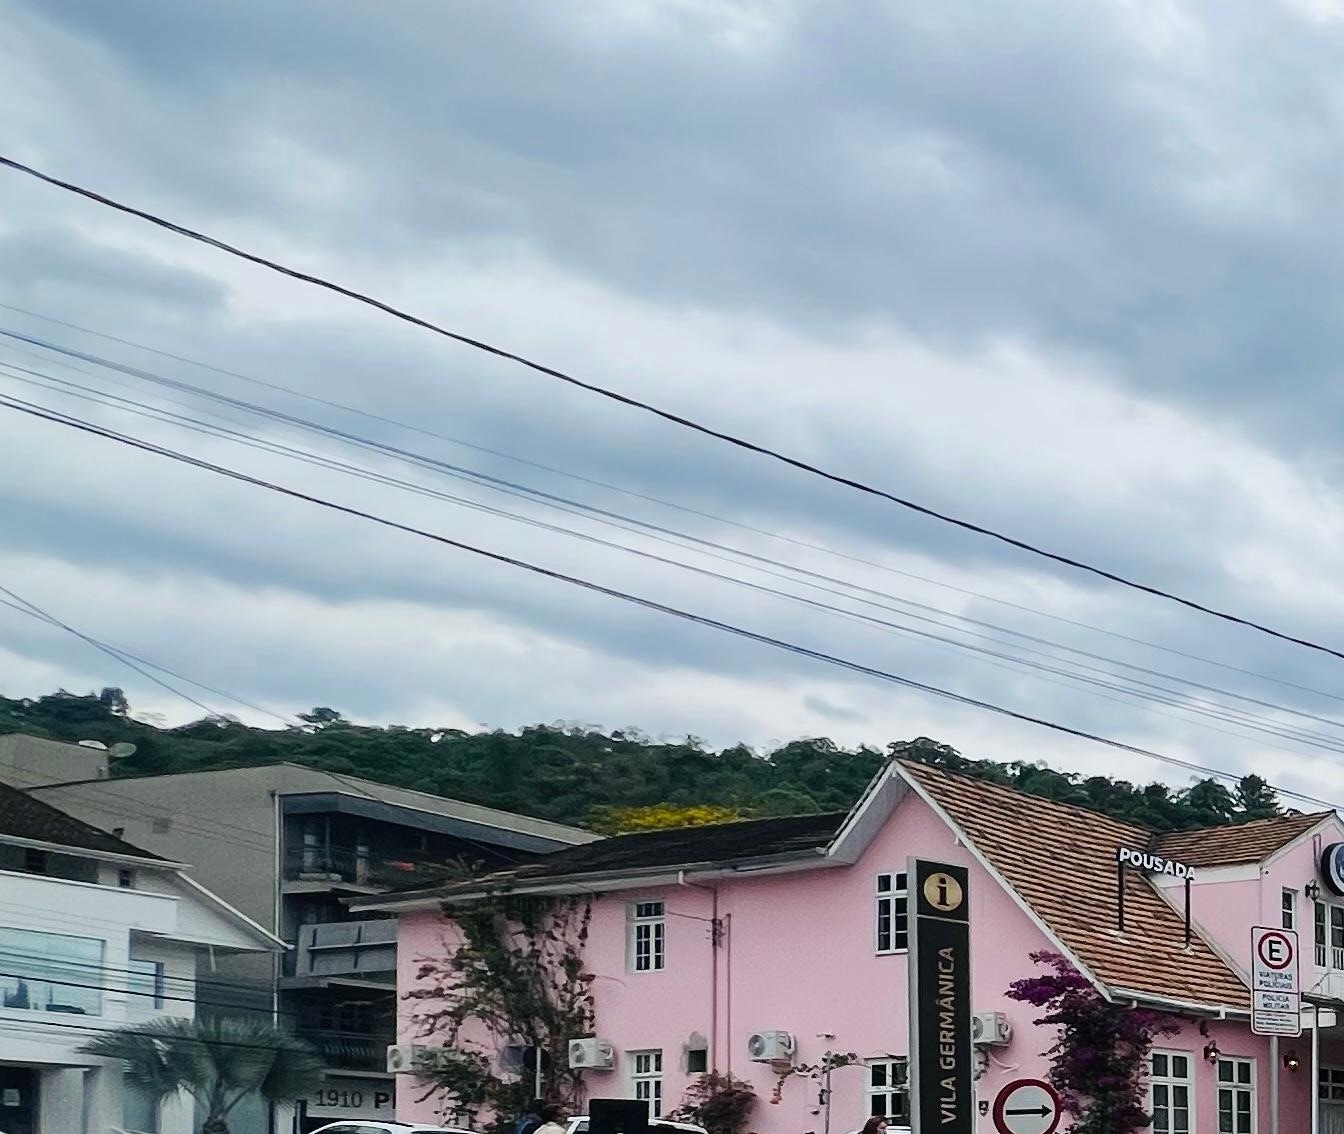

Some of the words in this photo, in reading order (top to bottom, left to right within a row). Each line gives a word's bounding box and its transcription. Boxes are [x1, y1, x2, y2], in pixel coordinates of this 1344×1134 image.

[1119, 847, 1197, 880] POUSADA
[1268, 940, 1282, 961] E
[936, 947, 956, 1070] GERMÂNICA
[315, 1089, 363, 1109] 1910
[940, 1076, 956, 1124] VILA
